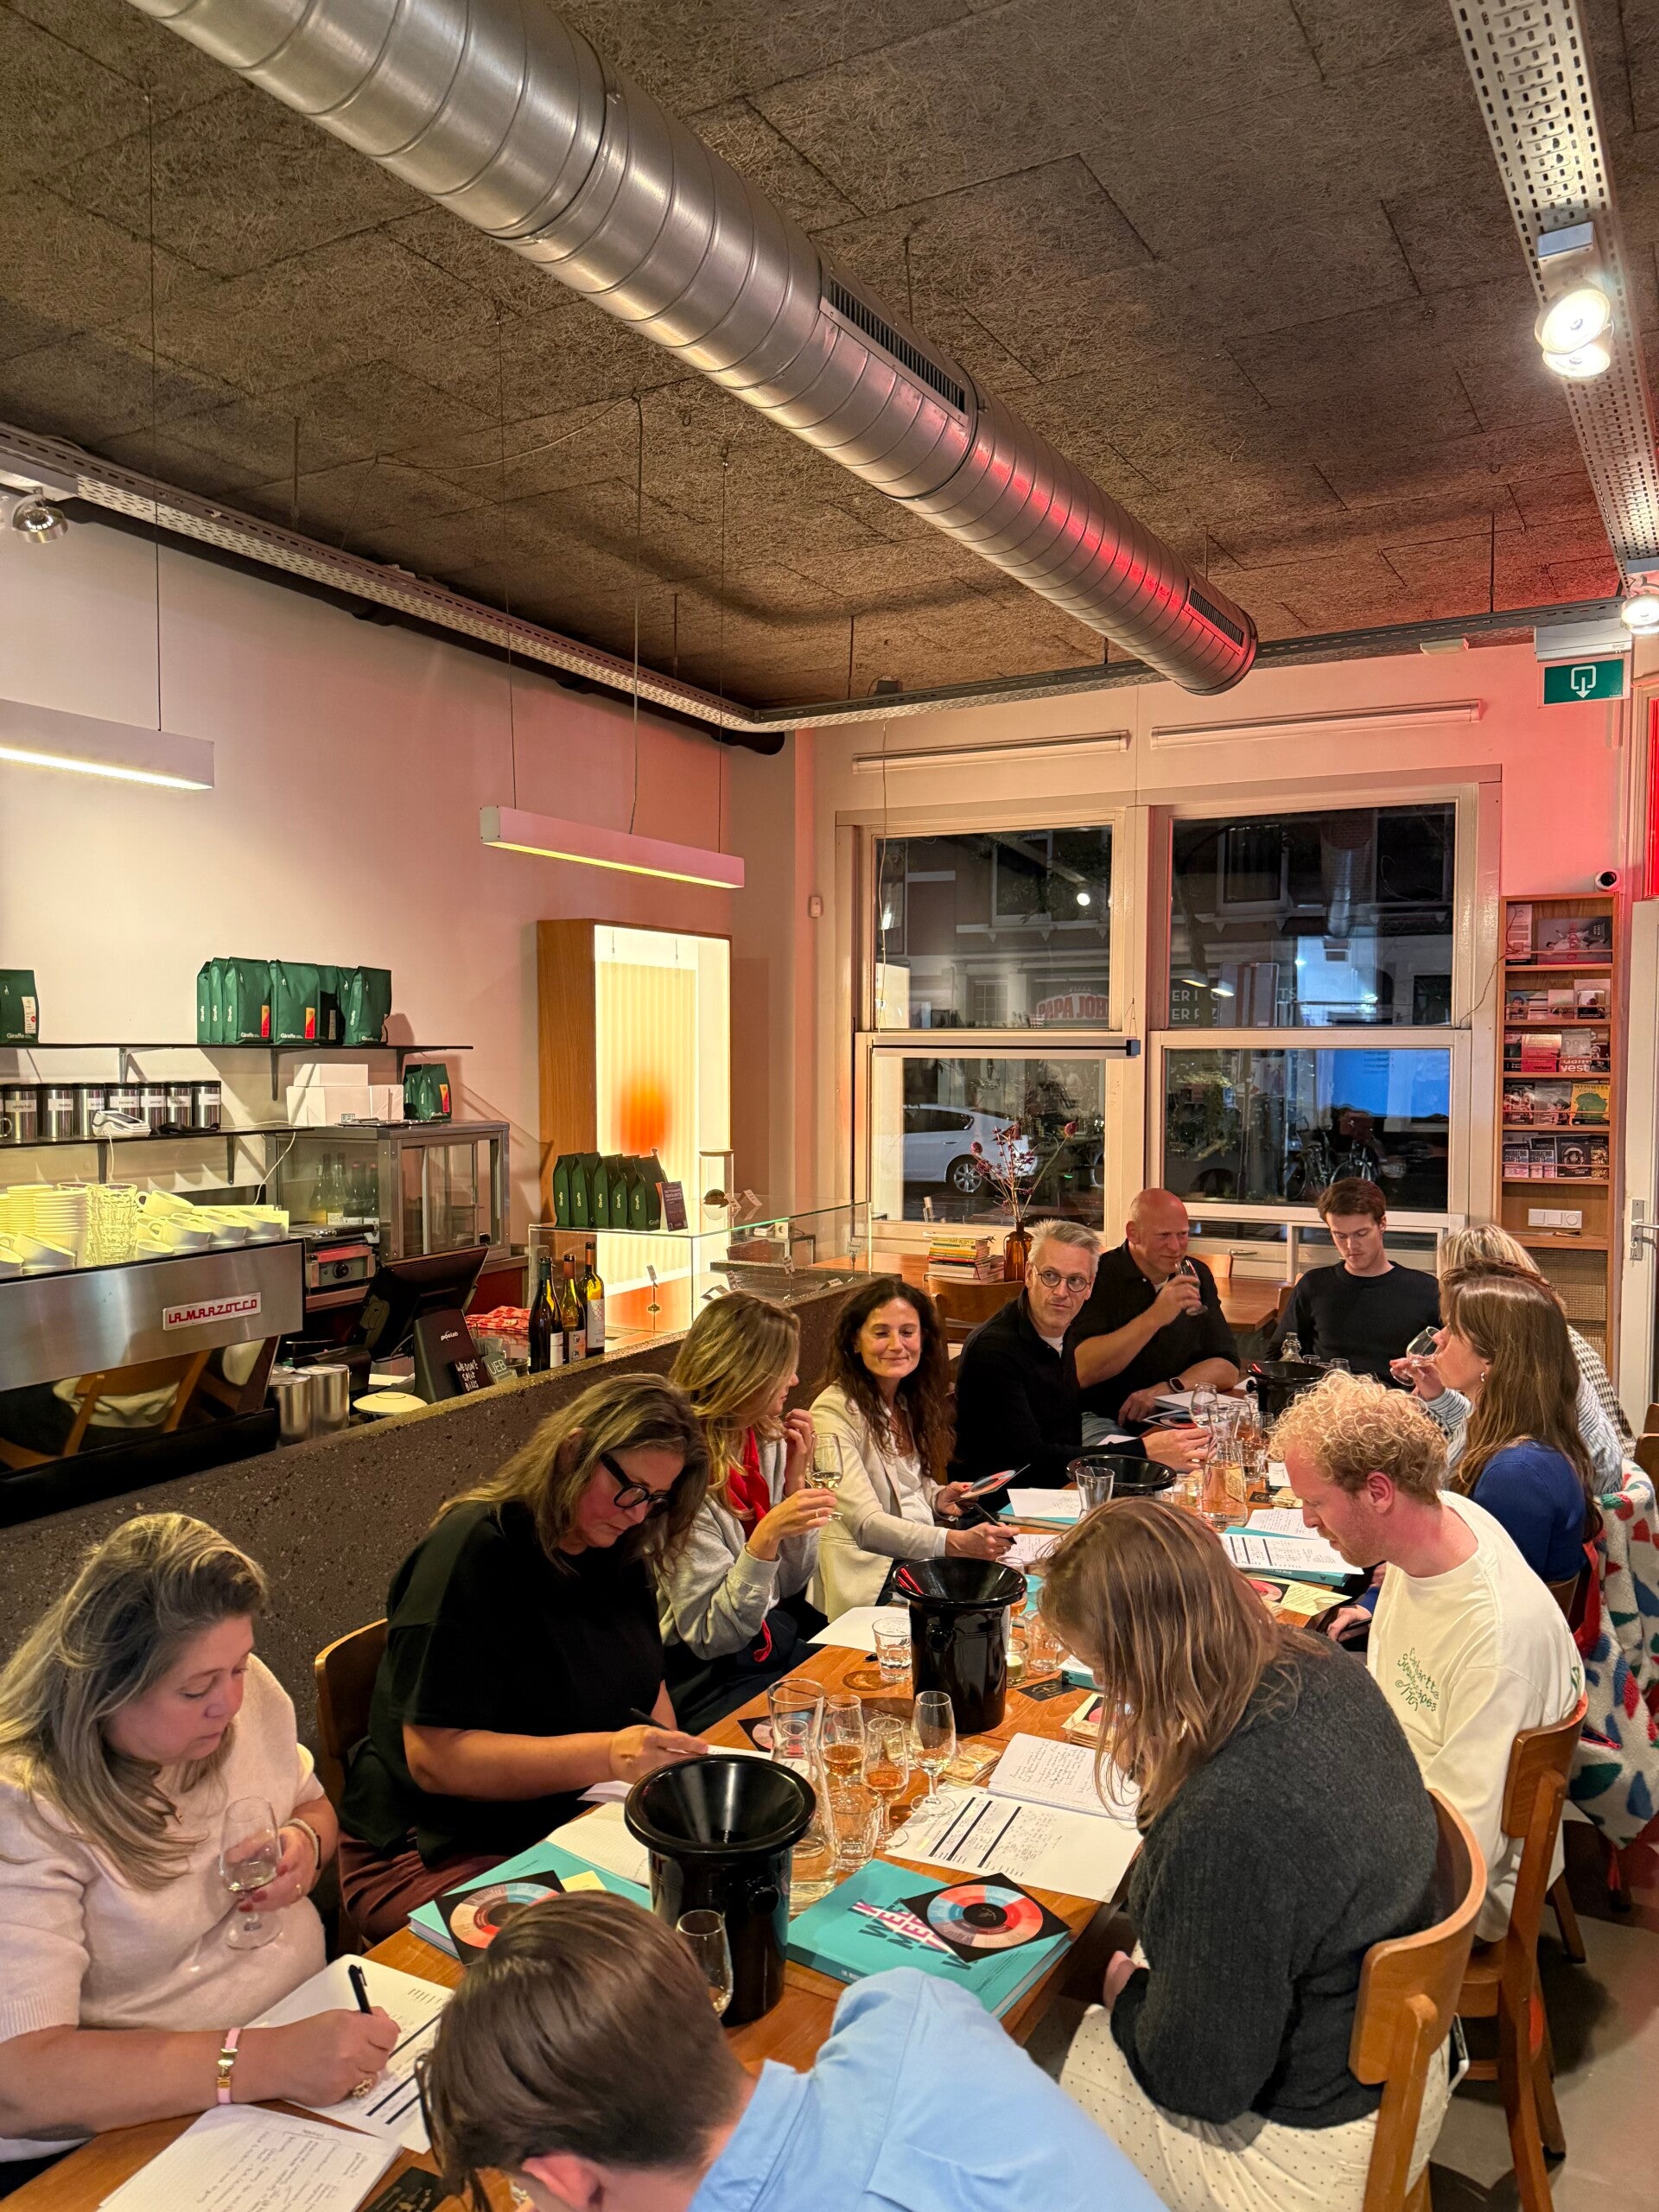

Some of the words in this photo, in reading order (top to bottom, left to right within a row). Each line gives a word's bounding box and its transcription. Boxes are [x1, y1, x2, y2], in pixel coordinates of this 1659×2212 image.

[1039, 996, 1074, 1018] PAPA
[1077, 995, 1109, 1018] JOH
[168, 1313, 181, 1325] LA
[187, 1299, 257, 1321] MARZOCCO
[487, 1359, 507, 1375] UEB
